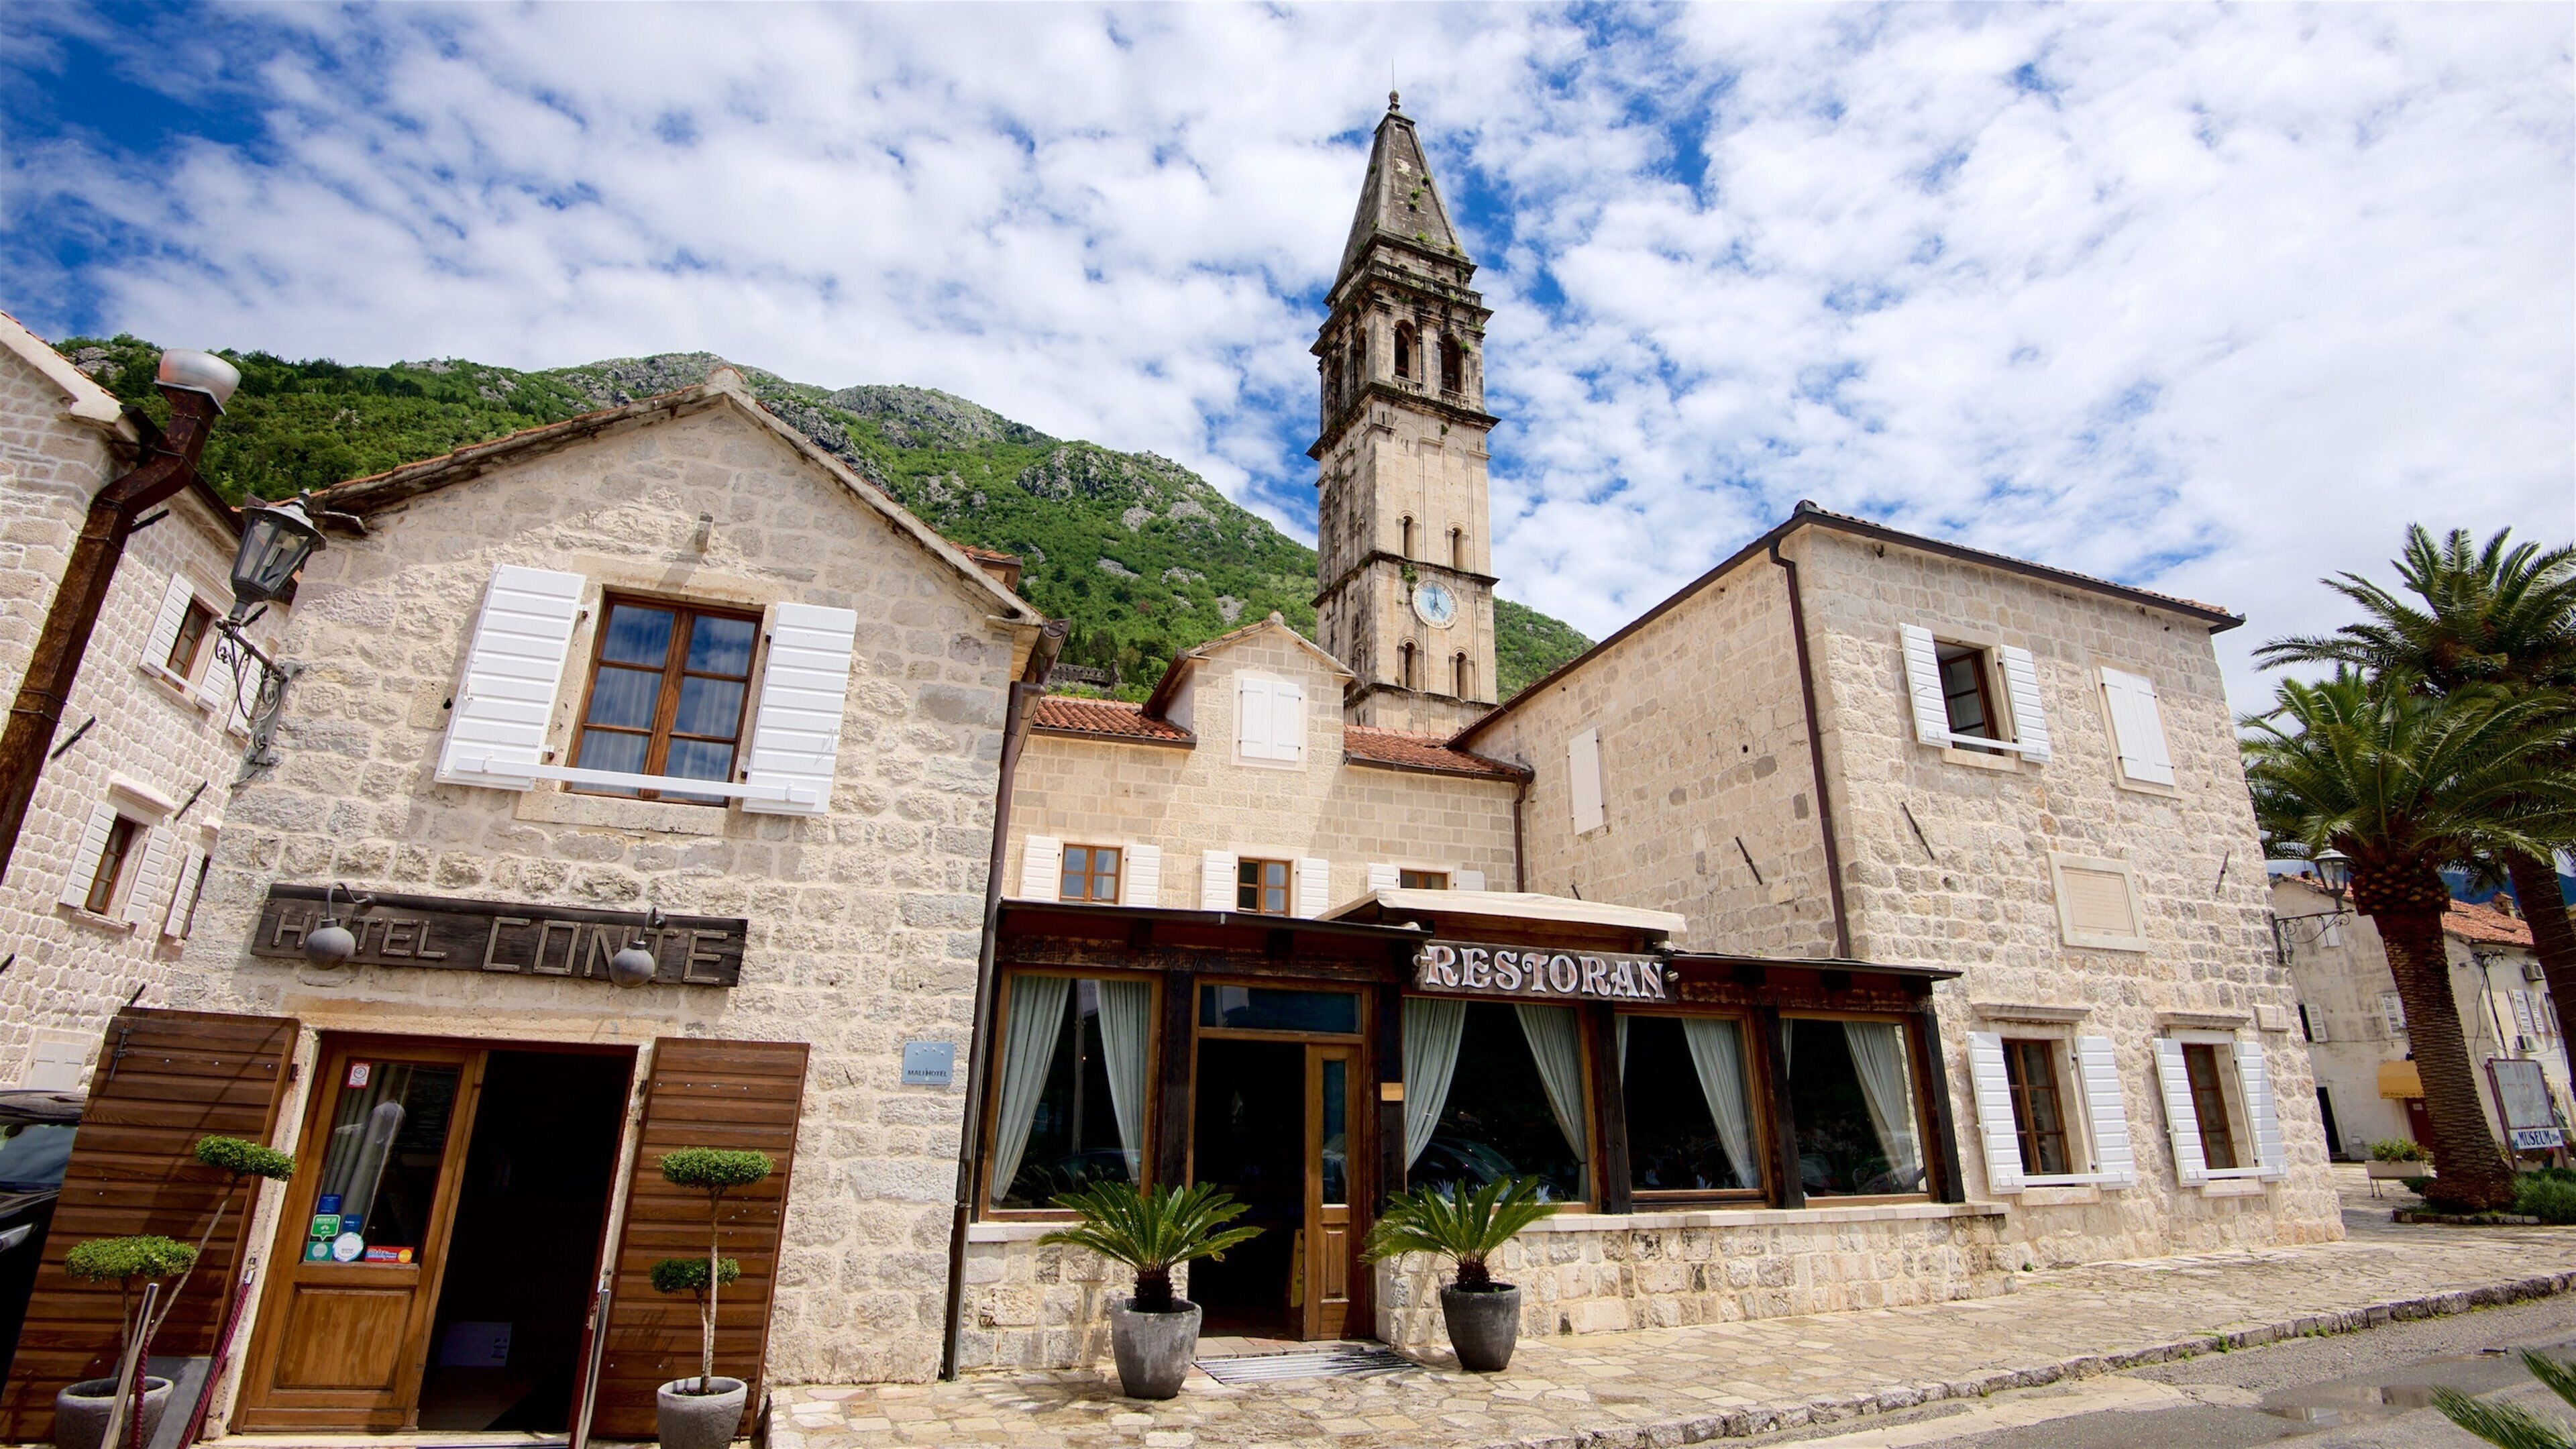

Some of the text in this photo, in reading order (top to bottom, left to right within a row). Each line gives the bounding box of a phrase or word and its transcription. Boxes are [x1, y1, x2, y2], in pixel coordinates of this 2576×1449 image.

[273, 910, 447, 959] HTEL
[1424, 945, 1666, 999] RESTORAN
[2518, 1130, 2553, 1146] MUSEUM
